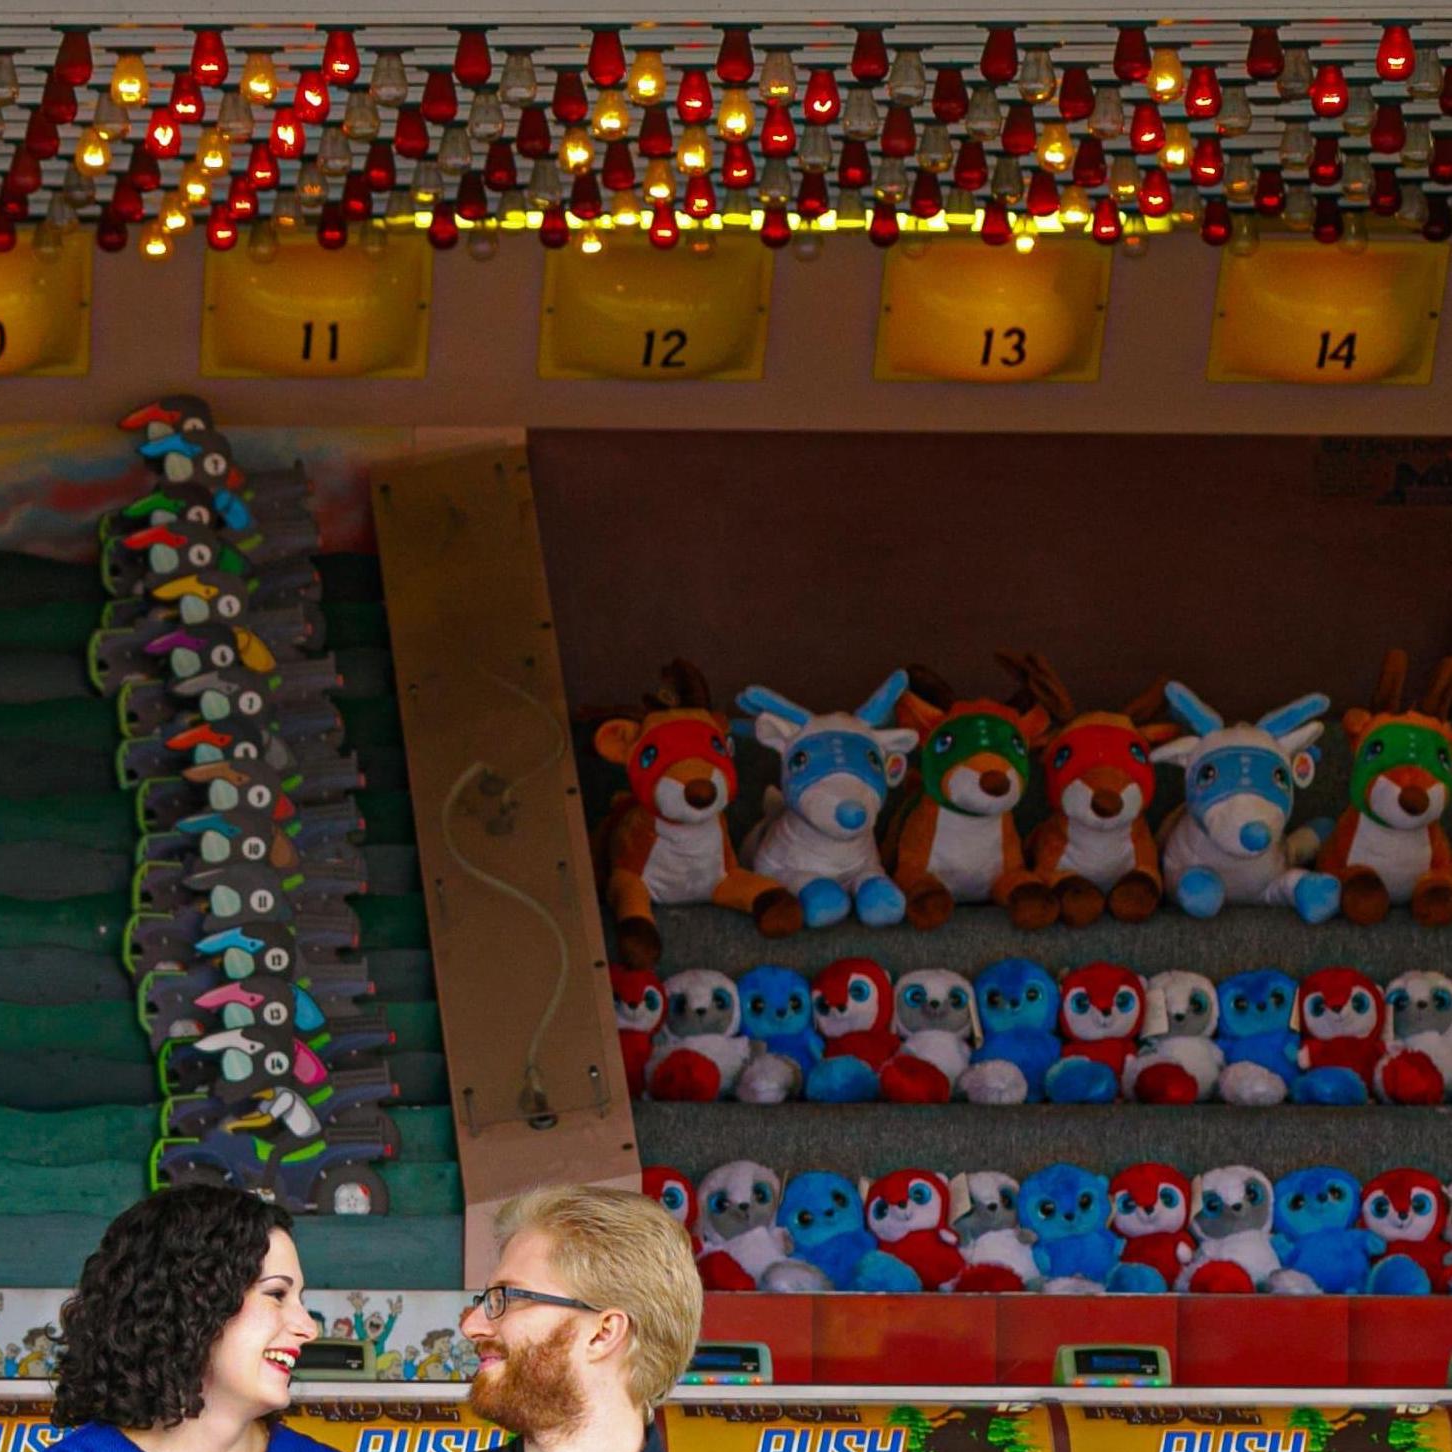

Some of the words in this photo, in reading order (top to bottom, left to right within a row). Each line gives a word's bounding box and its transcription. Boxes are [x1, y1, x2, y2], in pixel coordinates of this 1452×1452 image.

[301, 320, 339, 362] 11
[641, 328, 688, 368] 12
[979, 326, 1028, 368] 13
[1314, 329, 1358, 371] 14
